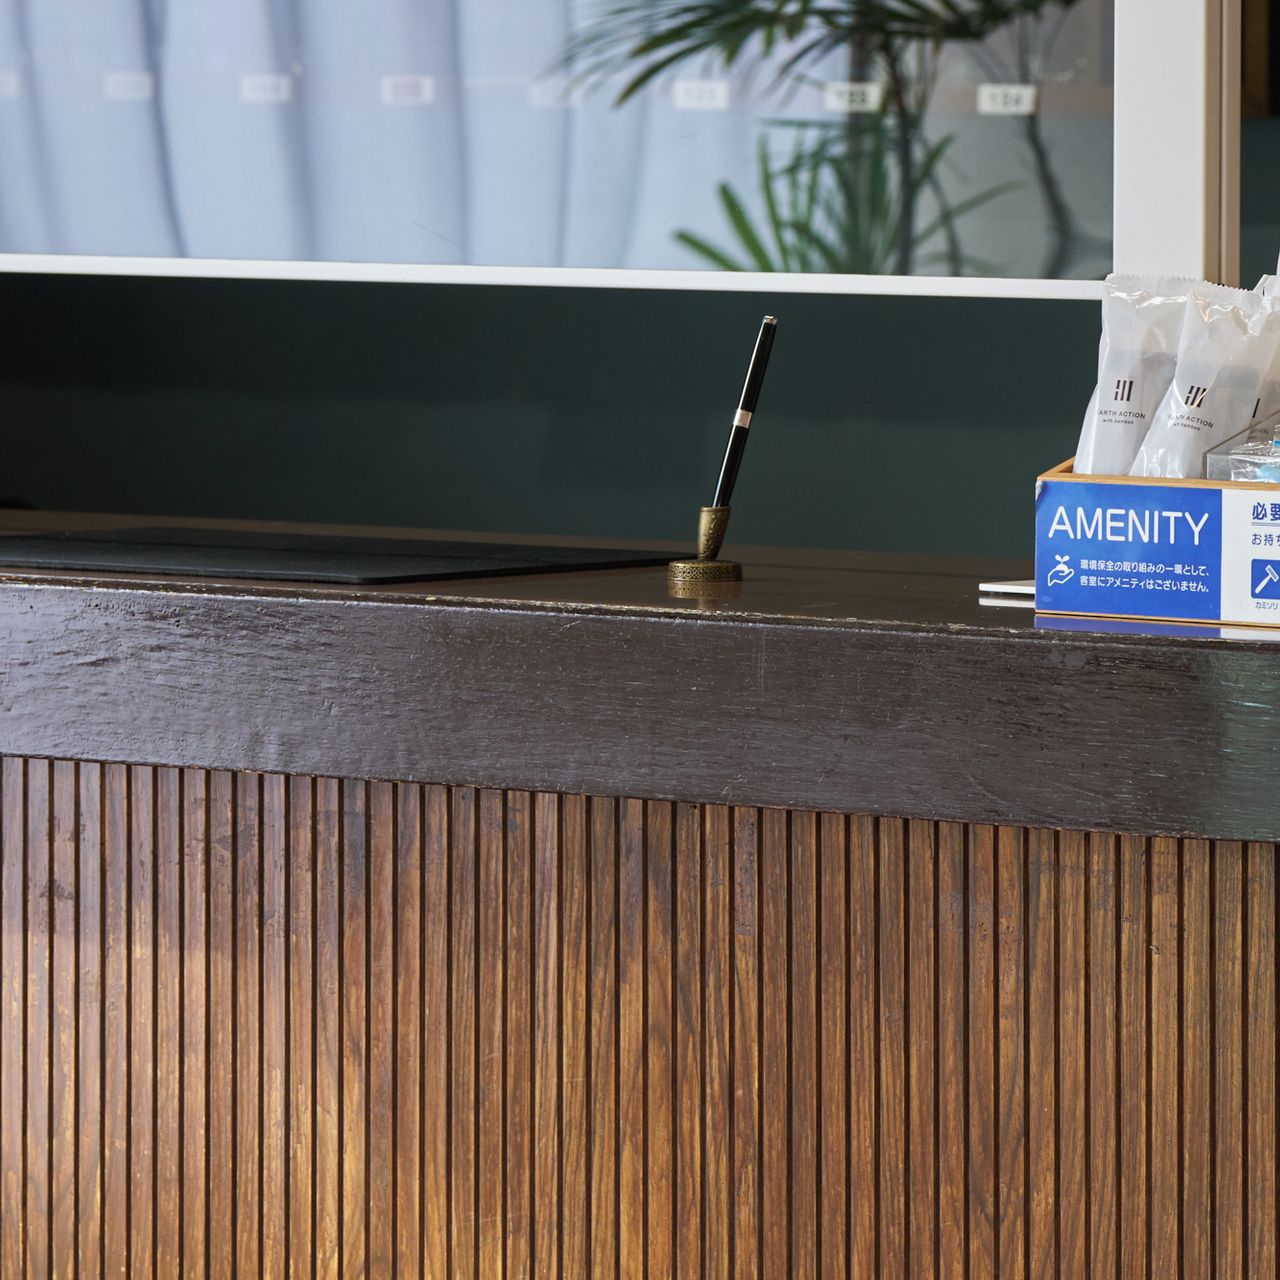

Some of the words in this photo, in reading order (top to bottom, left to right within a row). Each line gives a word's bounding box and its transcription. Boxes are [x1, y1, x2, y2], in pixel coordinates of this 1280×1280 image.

[1119, 411, 1146, 420] ACTION
[1186, 416, 1214, 428] ACTION
[1048, 506, 1209, 546] AMENITY
[1080, 560, 1209, 576] 環境保全の取り組みの一環として、
[1080, 575, 1209, 592] 客室にアメニティはございません。
[1255, 601, 1279, 610] カミソリ
